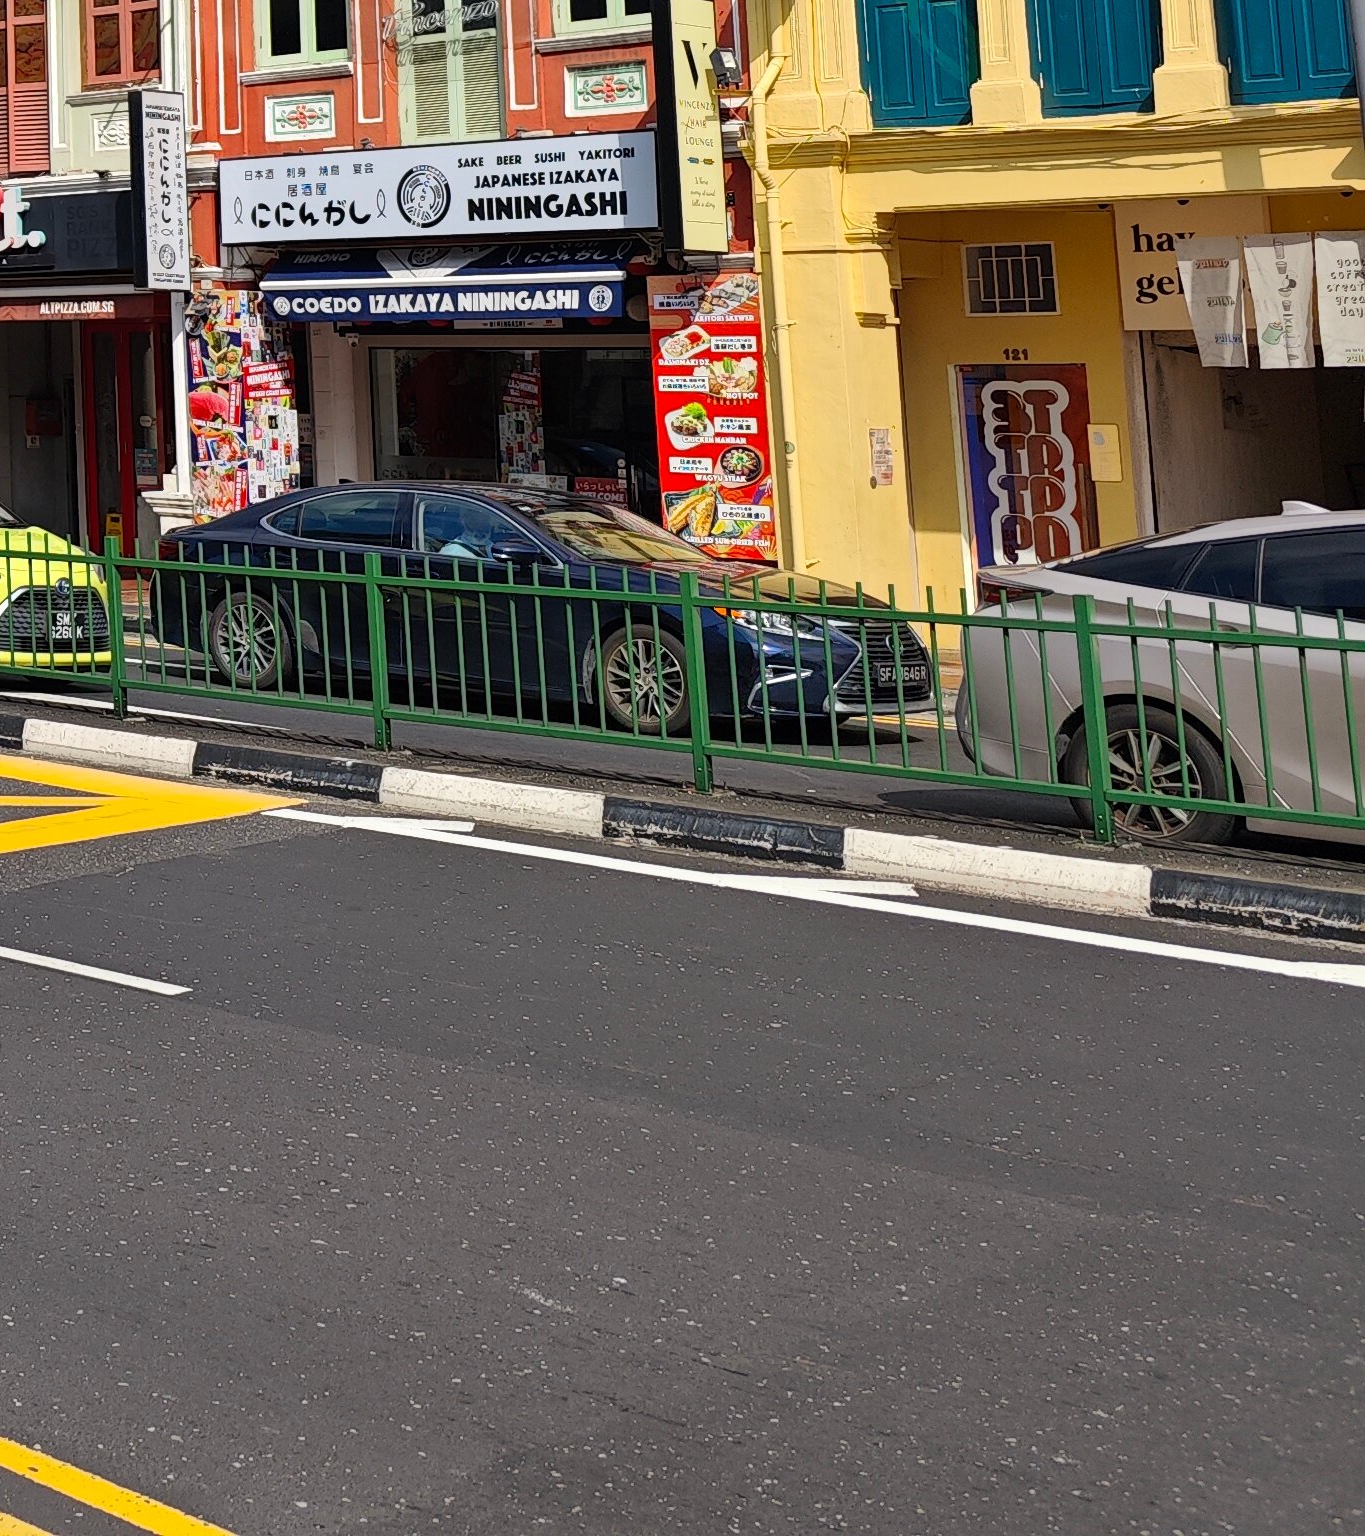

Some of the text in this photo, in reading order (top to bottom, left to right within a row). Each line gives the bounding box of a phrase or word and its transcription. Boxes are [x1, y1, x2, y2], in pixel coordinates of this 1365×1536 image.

[685, 137, 714, 147] LOUNGE
[458, 147, 635, 168] SAKE BEER SUSHI YAKITORI
[244, 168, 274, 181] 日本酒
[474, 168, 619, 188] JAPANESE IZAKAYA
[287, 182, 327, 198] 居酒屋
[467, 191, 628, 221] NININGASHI
[250, 199, 371, 229] ににんがし
[293, 253, 351, 264] HIMONO
[40, 300, 114, 315] ALTPIZZA.COM.SG
[291, 289, 579, 313] COEDO IZAKAYA NININGASHI
[1003, 348, 1028, 360] 121
[694, 473, 747, 482] WAGYU STEAK
